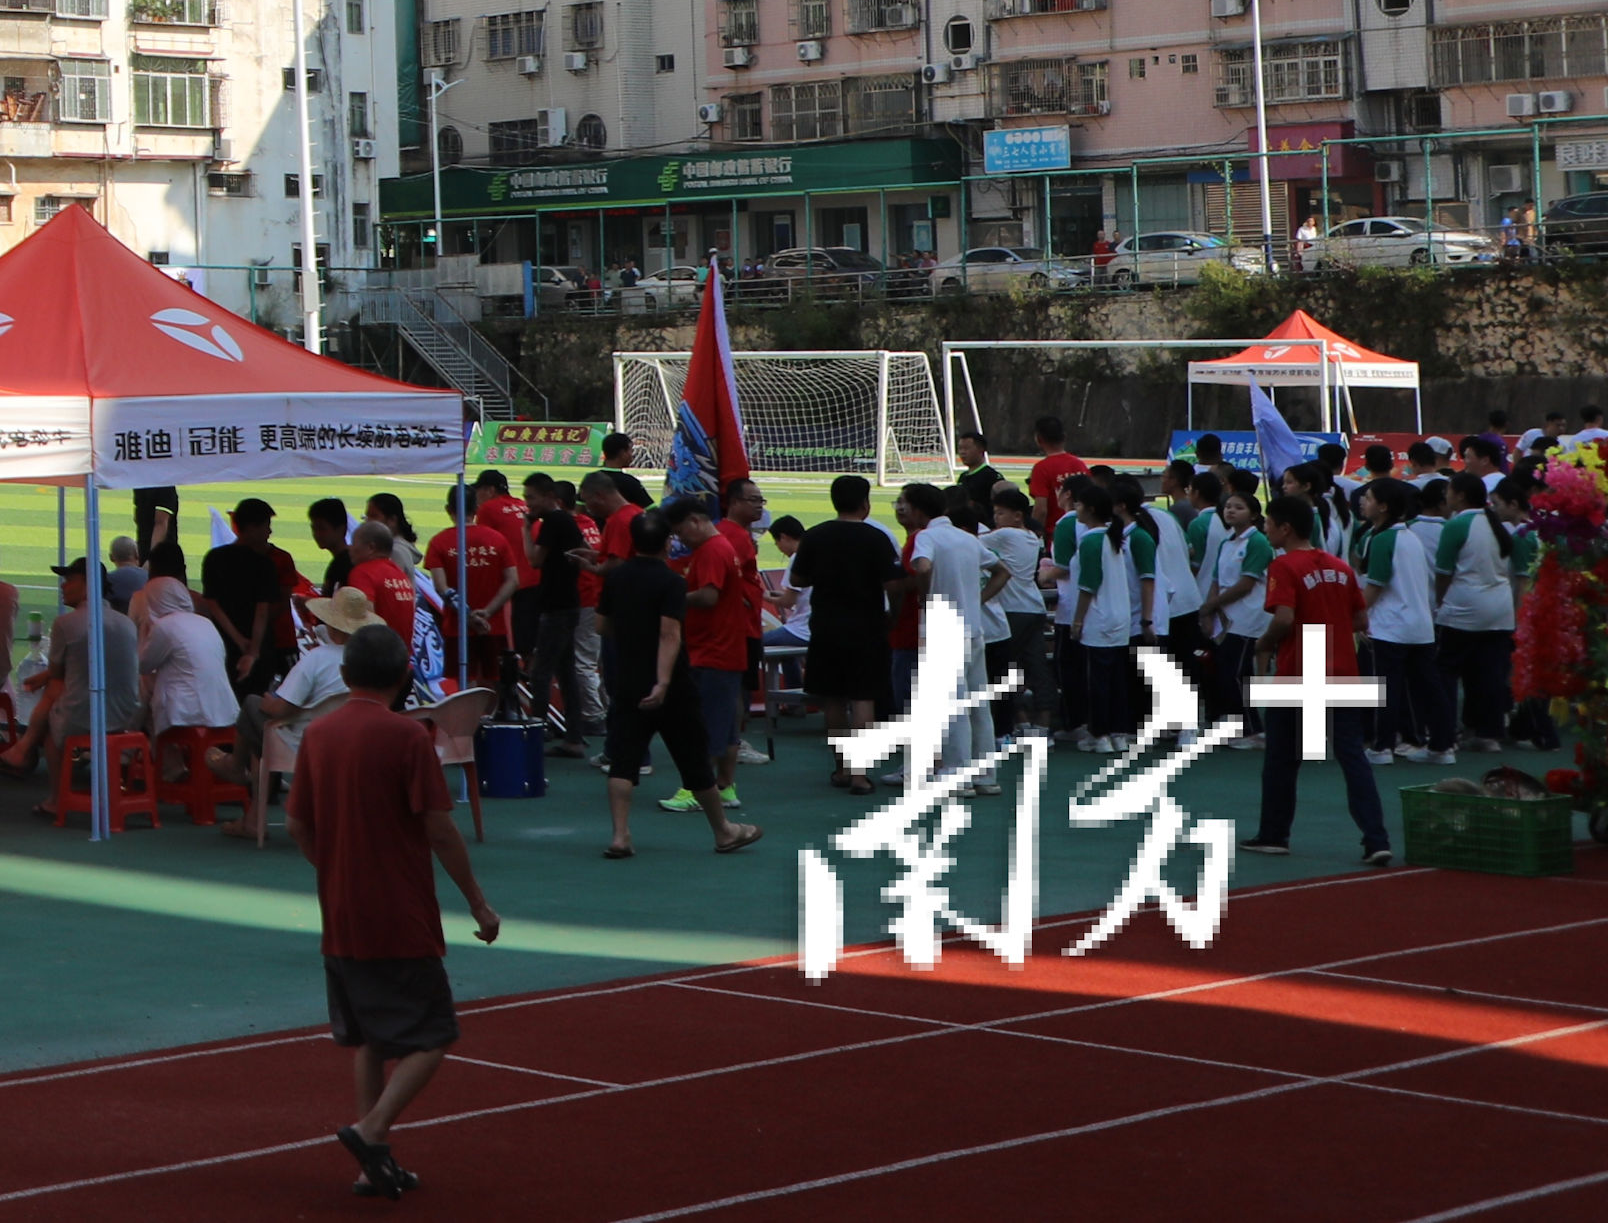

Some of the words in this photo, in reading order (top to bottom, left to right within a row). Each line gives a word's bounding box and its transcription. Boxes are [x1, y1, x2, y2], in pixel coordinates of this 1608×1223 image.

[683, 156, 793, 180] 中国邮政储蓄银行
[113, 428, 173, 461] 雅迪
[259, 421, 447, 453] 更高端的长续航电动车
